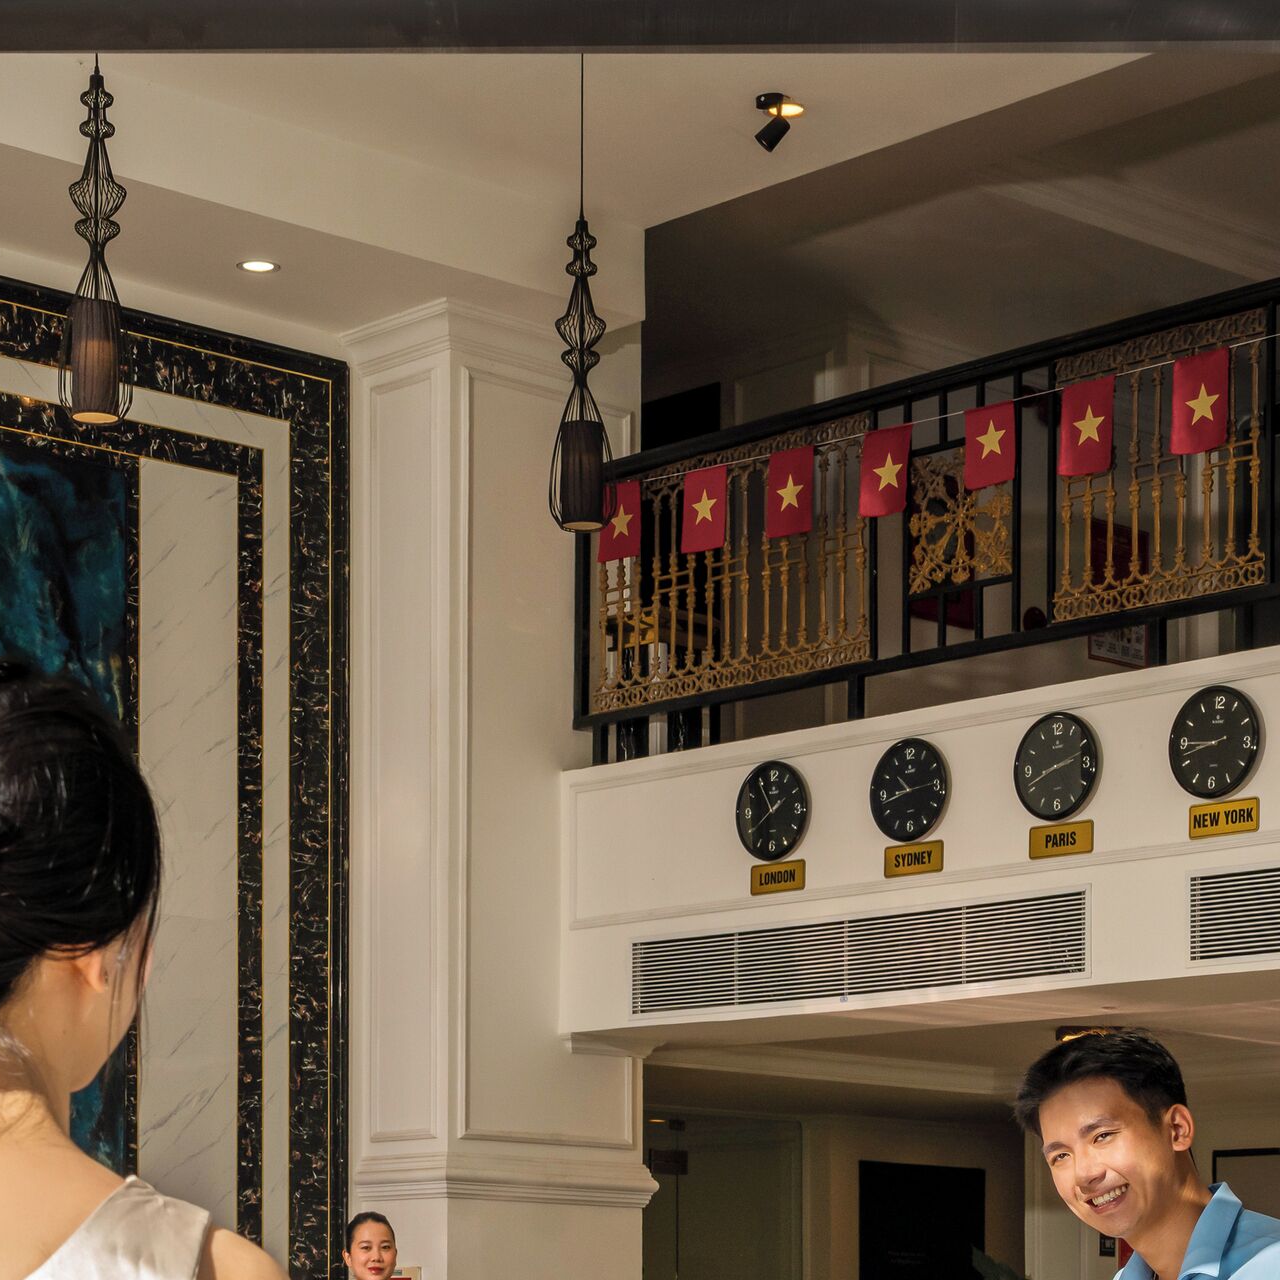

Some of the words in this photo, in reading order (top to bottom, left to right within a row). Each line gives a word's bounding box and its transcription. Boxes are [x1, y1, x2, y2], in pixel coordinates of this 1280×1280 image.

[1214, 695, 1225, 709] 12
[1052, 722, 1063, 735] 12
[1180, 736, 1188, 750] 9
[1242, 736, 1251, 749] 3
[904, 748, 915, 760] 12
[1082, 756, 1090, 768] 3
[770, 769, 779, 782] 12
[1024, 765, 1032, 778] 9
[933, 779, 940, 791] 3
[1207, 776, 1215, 789] 6
[880, 790, 887, 801] 9
[794, 803, 801, 814] 3
[1053, 798, 1061, 811] 6
[745, 808, 752, 819] 9
[1193, 811, 1221, 829] NEW
[1223, 808, 1254, 826] YORK
[906, 820, 914, 832] 6
[768, 840, 776, 852] 6
[1044, 831, 1077, 849] PARIS
[894, 850, 933, 868] SYDNEY
[758, 869, 796, 887] LONDON
